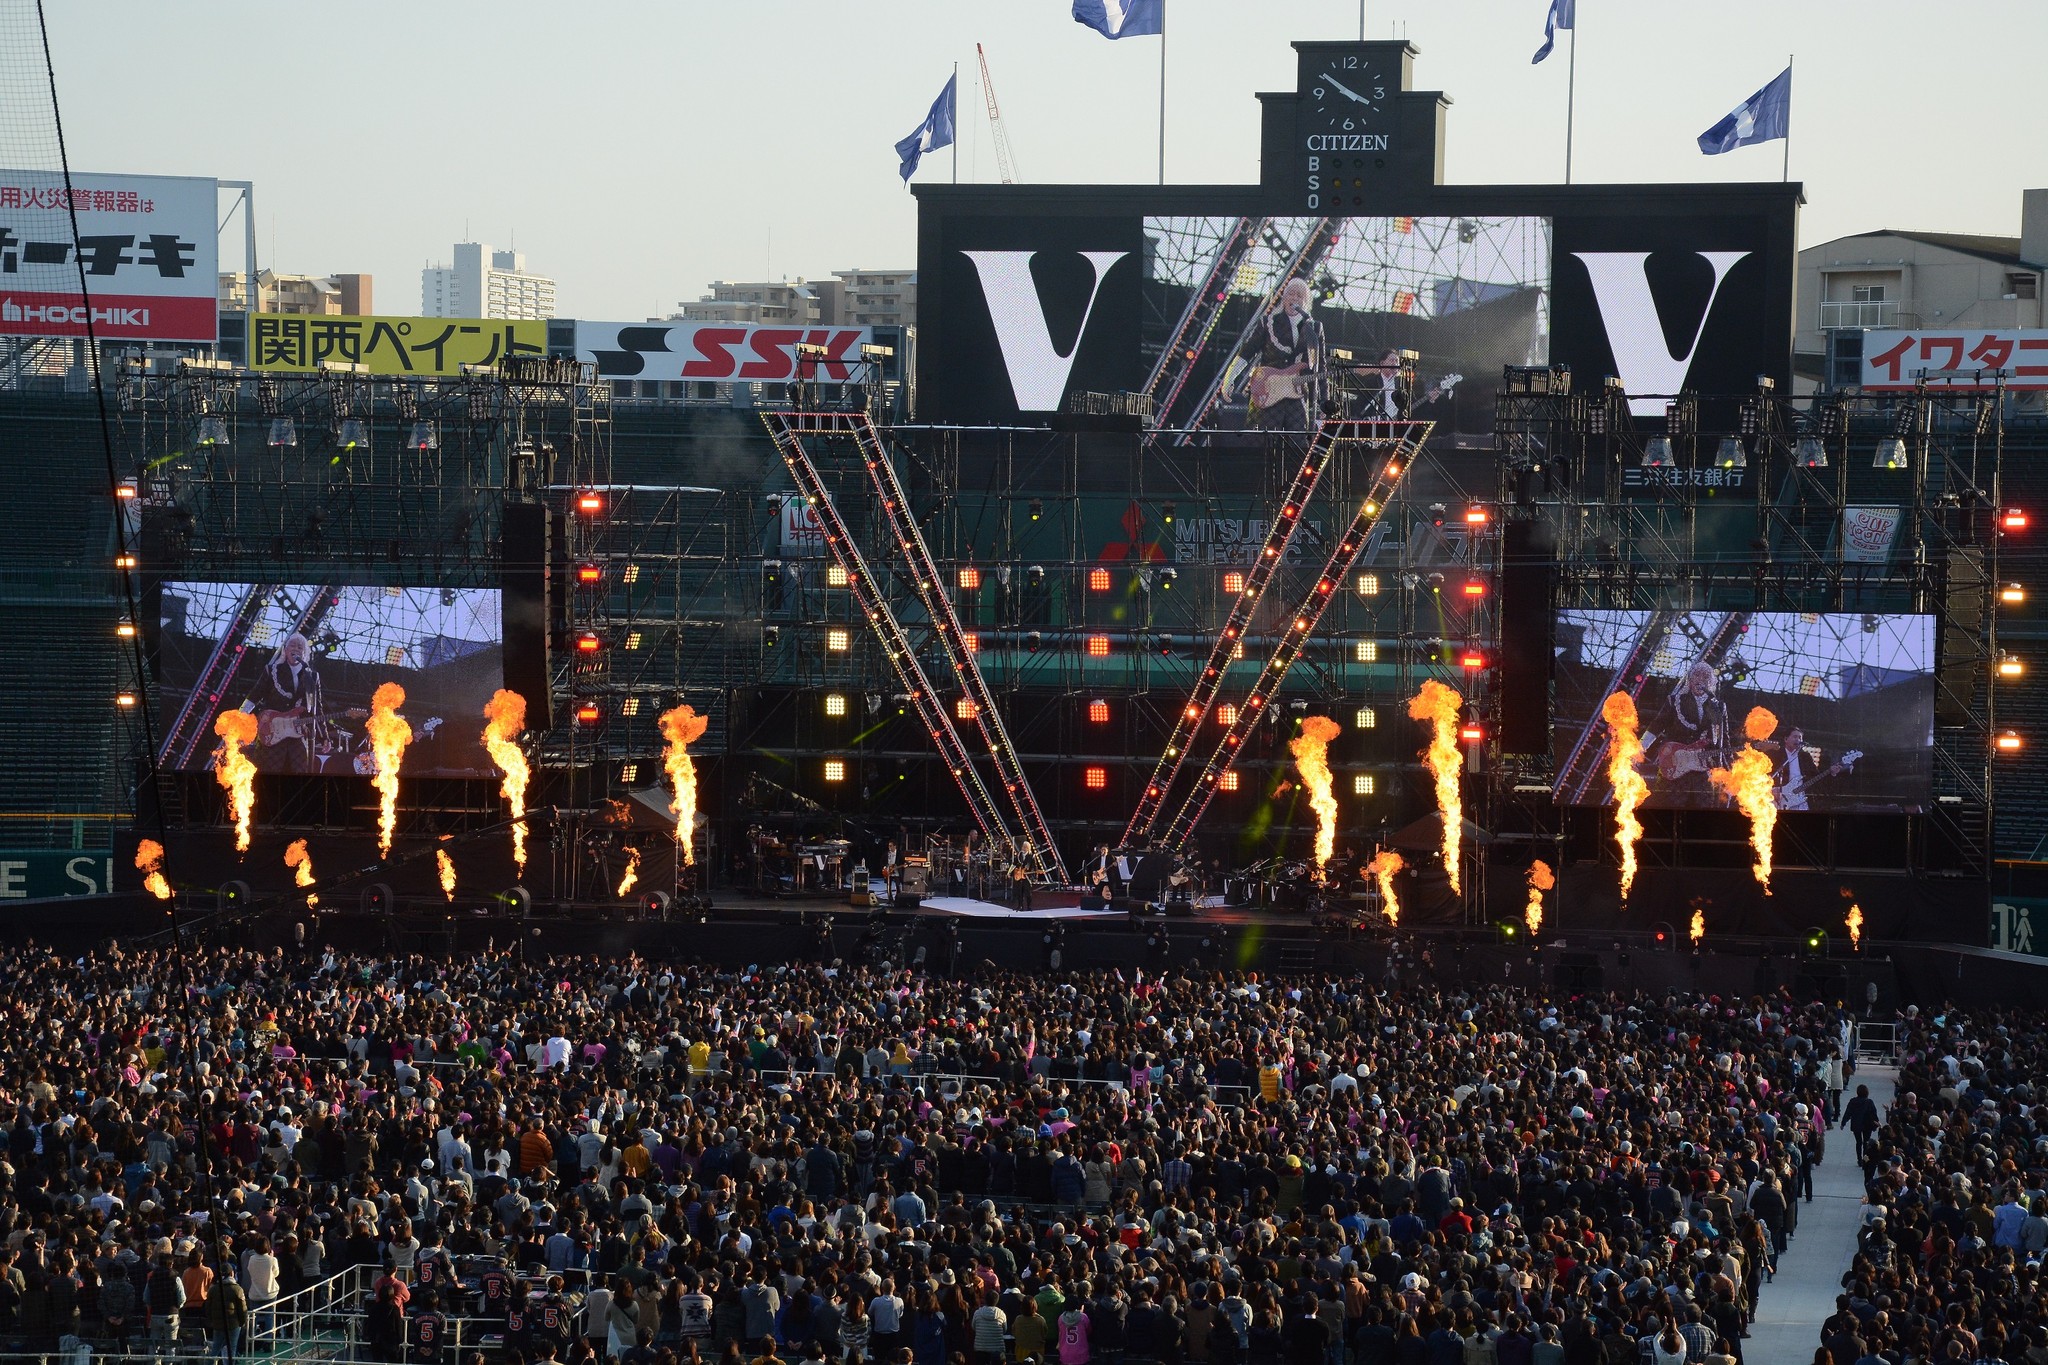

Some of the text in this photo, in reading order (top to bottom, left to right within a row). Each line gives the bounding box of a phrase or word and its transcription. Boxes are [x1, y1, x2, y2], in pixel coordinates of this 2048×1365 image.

[1343, 56, 1358, 69] 12
[1312, 87, 1325, 100] 9
[1373, 87, 1385, 100] 3
[1342, 118, 1355, 131] 6
[1307, 134, 1389, 151] CITIZEN
[1308, 156, 1320, 172] B
[1308, 175, 1320, 190] S
[1307, 193, 1319, 209] O
[23, 305, 149, 326] HOCHIKI
[960, 250, 1130, 412] V
[1570, 251, 1753, 417] V
[255, 318, 543, 372] 関西ペイント
[681, 328, 863, 380] SSK
[1869, 334, 2048, 382] イワタニ
[420, 1262, 433, 1283] 5
[487, 1279, 501, 1299] 5
[509, 1311, 523, 1331] 5
[544, 1308, 558, 1328] 5
[420, 1322, 434, 1342] 5
[1066, 1326, 1079, 1345] 5
